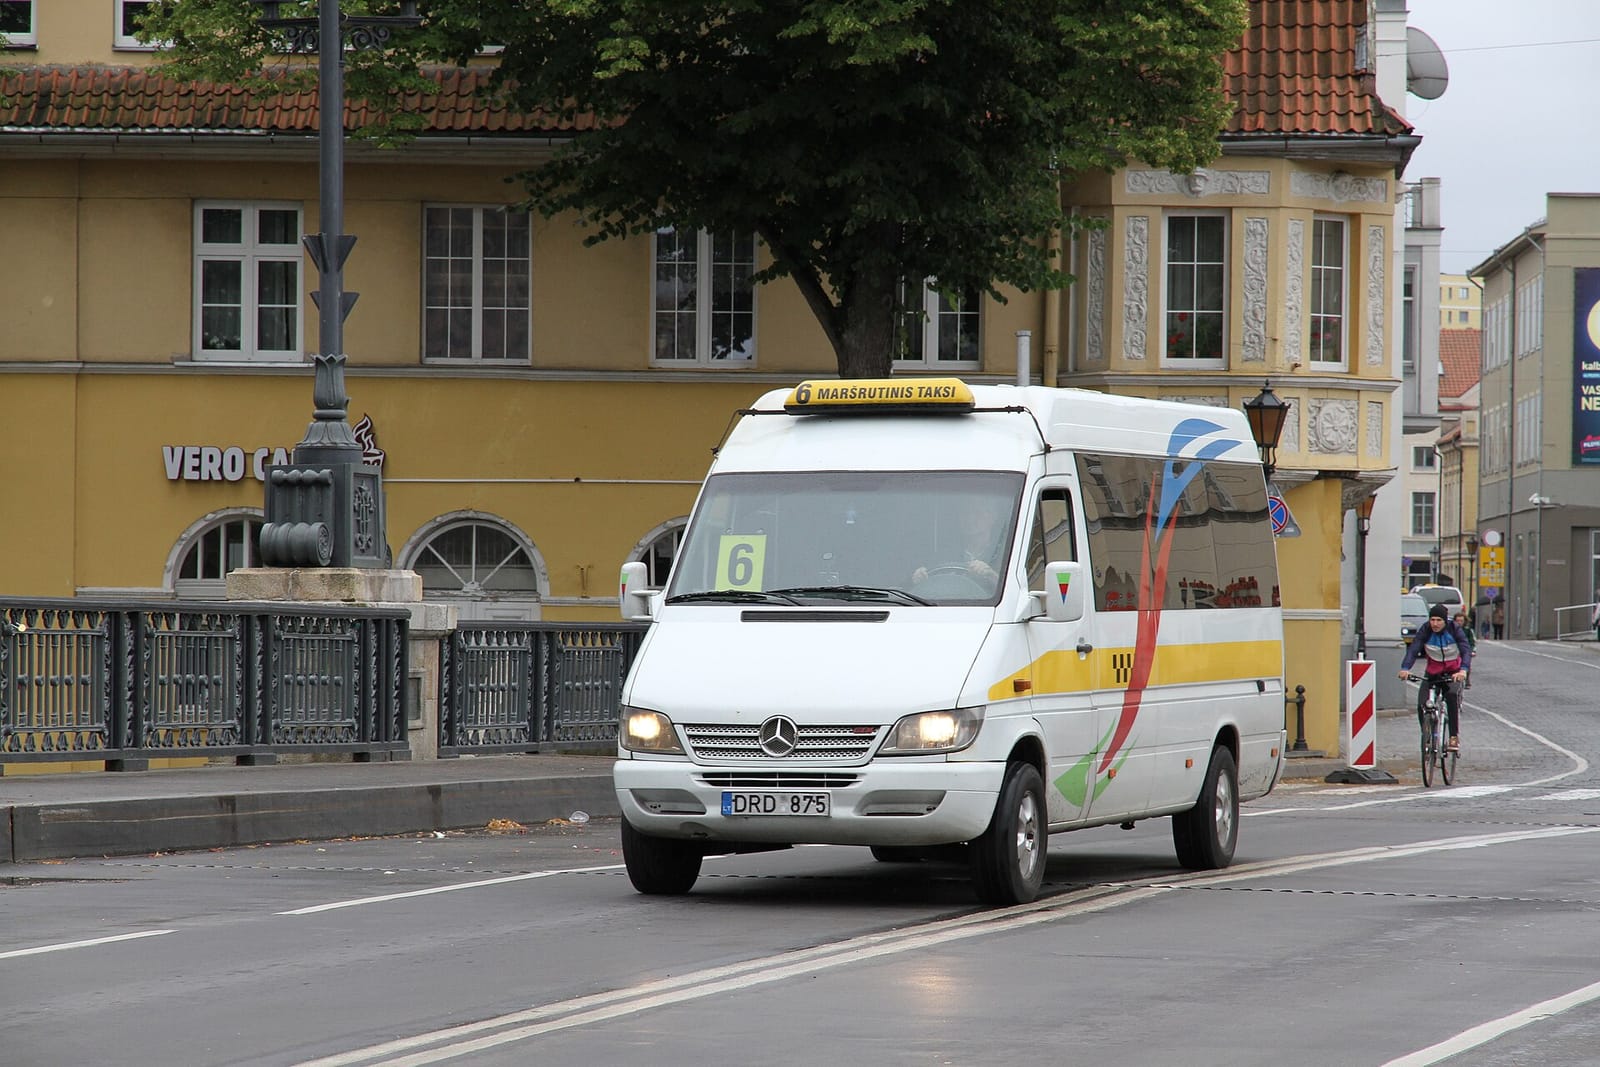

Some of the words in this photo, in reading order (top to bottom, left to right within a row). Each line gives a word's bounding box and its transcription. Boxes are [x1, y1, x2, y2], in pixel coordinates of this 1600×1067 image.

[796, 383, 812, 404] 6
[817, 385, 914, 400] MARŠRUTINIS
[917, 386, 956, 399] TAKSI
[162, 446, 245, 481] VERO
[253, 446, 296, 481] CA
[727, 543, 754, 587] 6
[734, 794, 776, 814] DRD
[790, 795, 826, 814] 875
